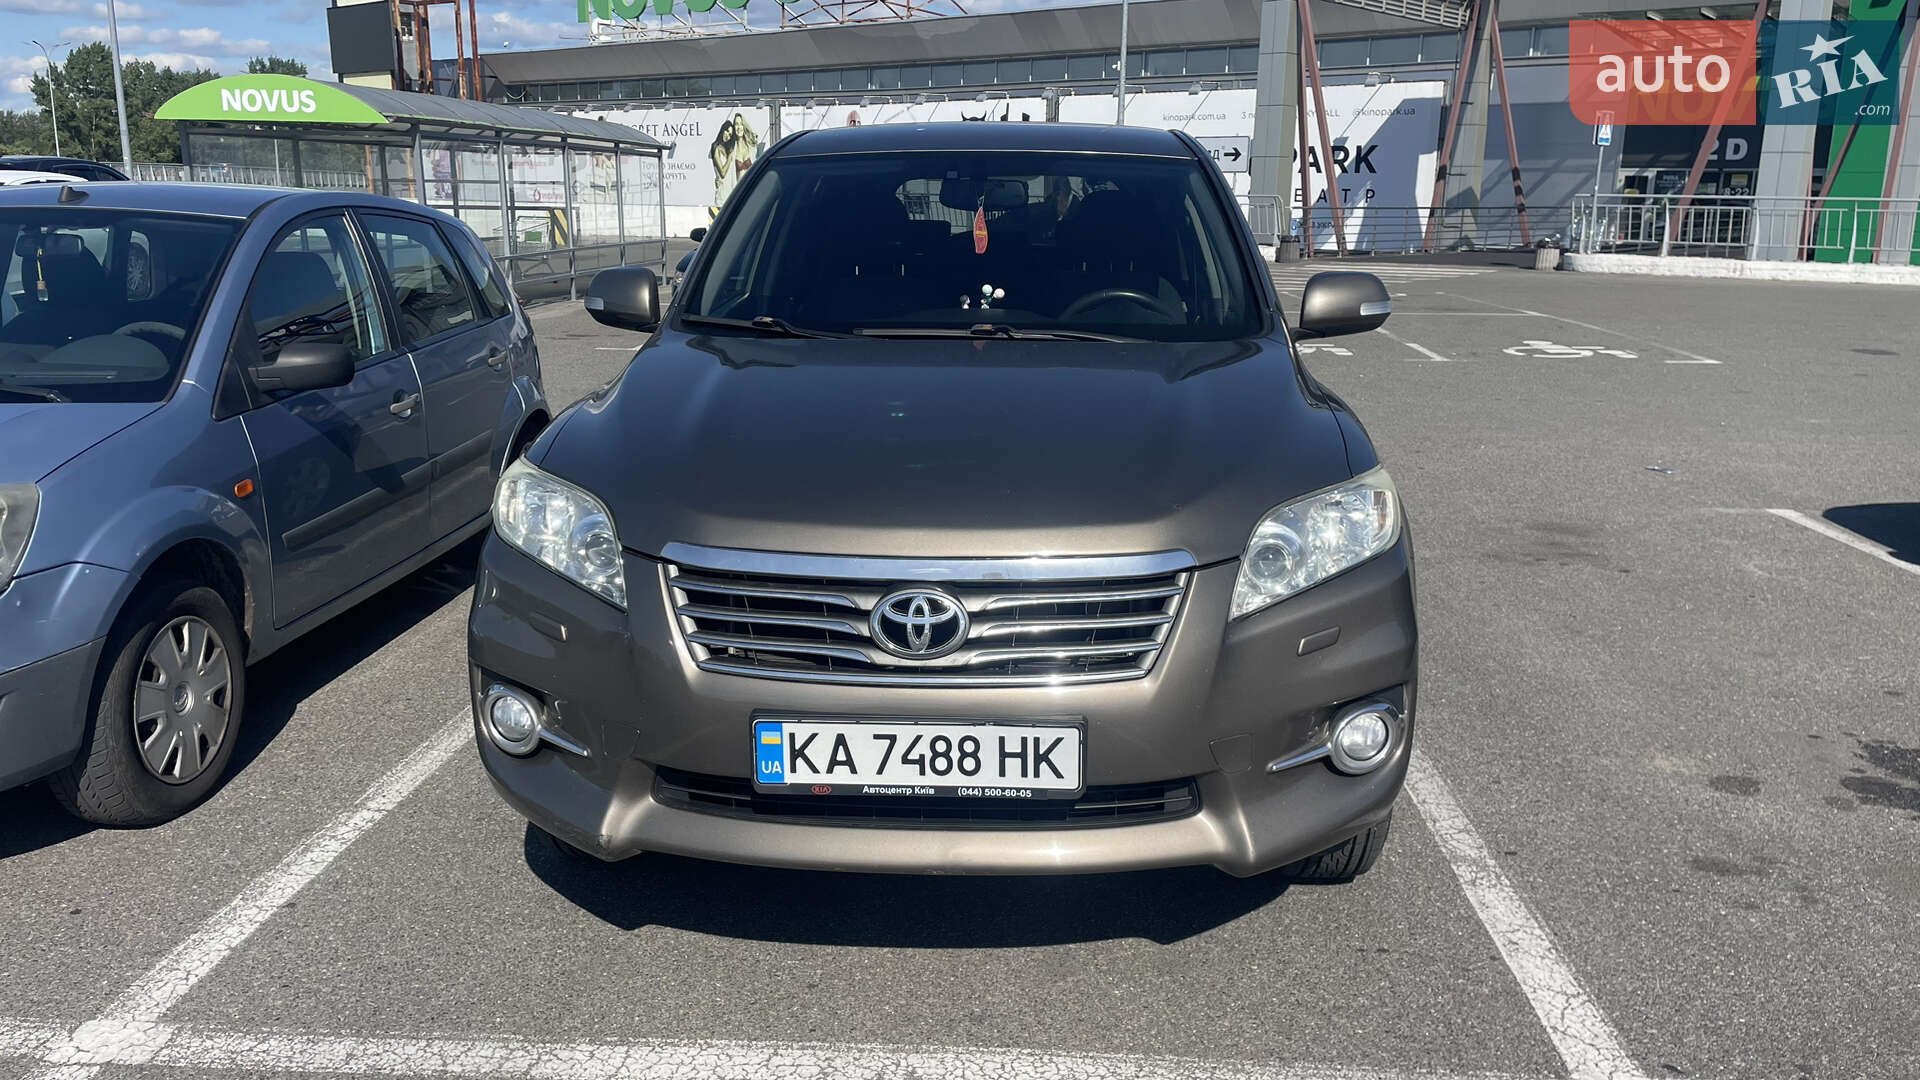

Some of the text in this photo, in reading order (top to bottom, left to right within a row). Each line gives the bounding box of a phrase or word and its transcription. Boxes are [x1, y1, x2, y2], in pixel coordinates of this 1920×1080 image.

[221, 88, 316, 113] NOVUS
[1162, 112, 1226, 122] kinopark.com.ua
[662, 121, 703, 137] ANGEL
[1293, 144, 1379, 174] ARK
[788, 732, 1065, 779] KA 7488 HK
[761, 760, 782, 774] UA
[813, 785, 831, 793] KIA
[862, 785, 935, 796] Автоцентр Київ
[957, 786, 1032, 798] (044) 500-60-05
